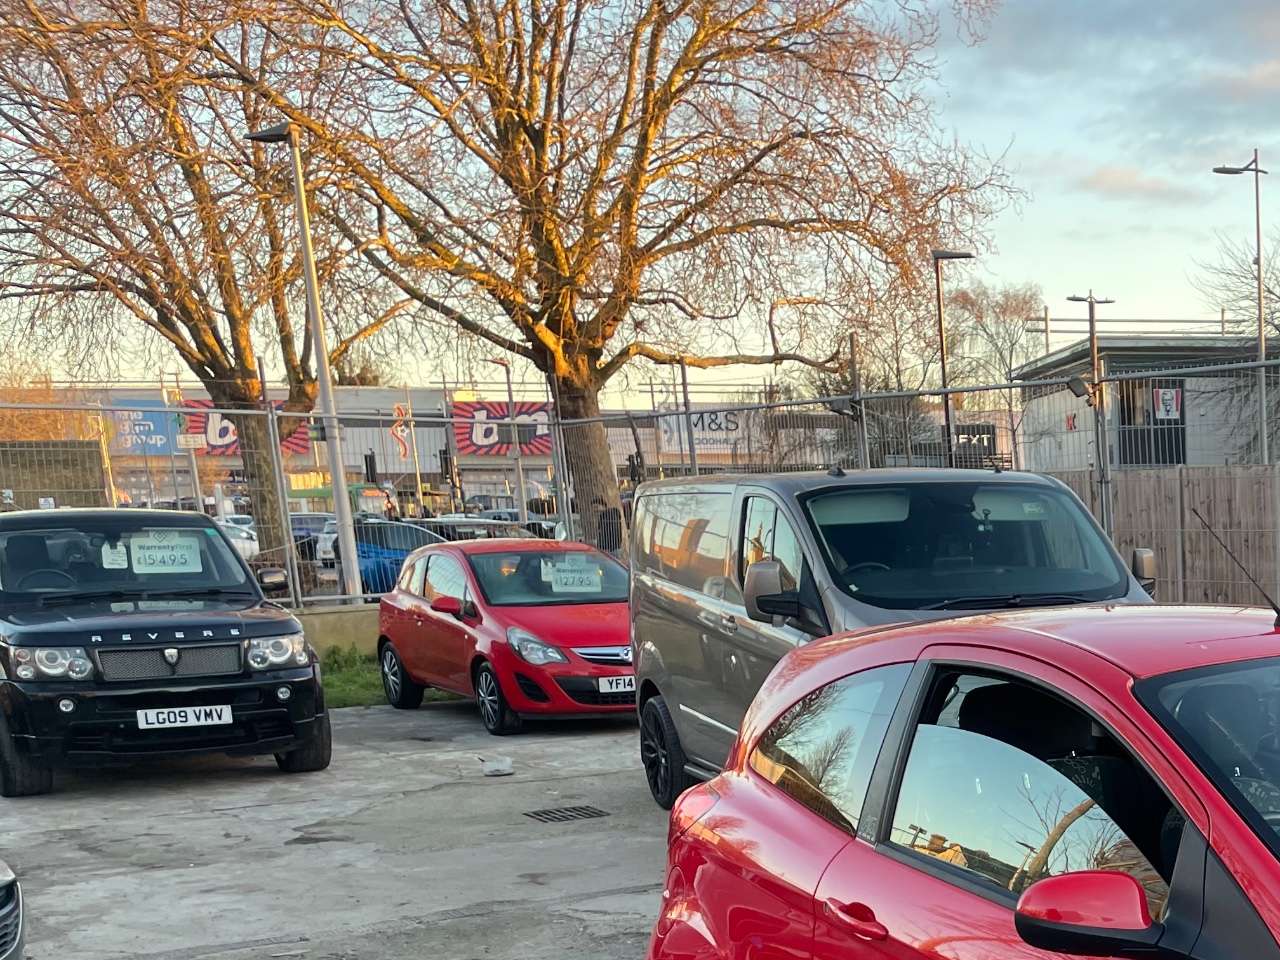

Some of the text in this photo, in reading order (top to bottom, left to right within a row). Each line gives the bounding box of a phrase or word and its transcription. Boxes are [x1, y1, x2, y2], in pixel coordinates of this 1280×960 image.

[954, 434, 991, 447] EXT
[91, 628, 240, 642] REVERE
[608, 679, 634, 690] YF14
[145, 708, 223, 725] LG09 VMV
